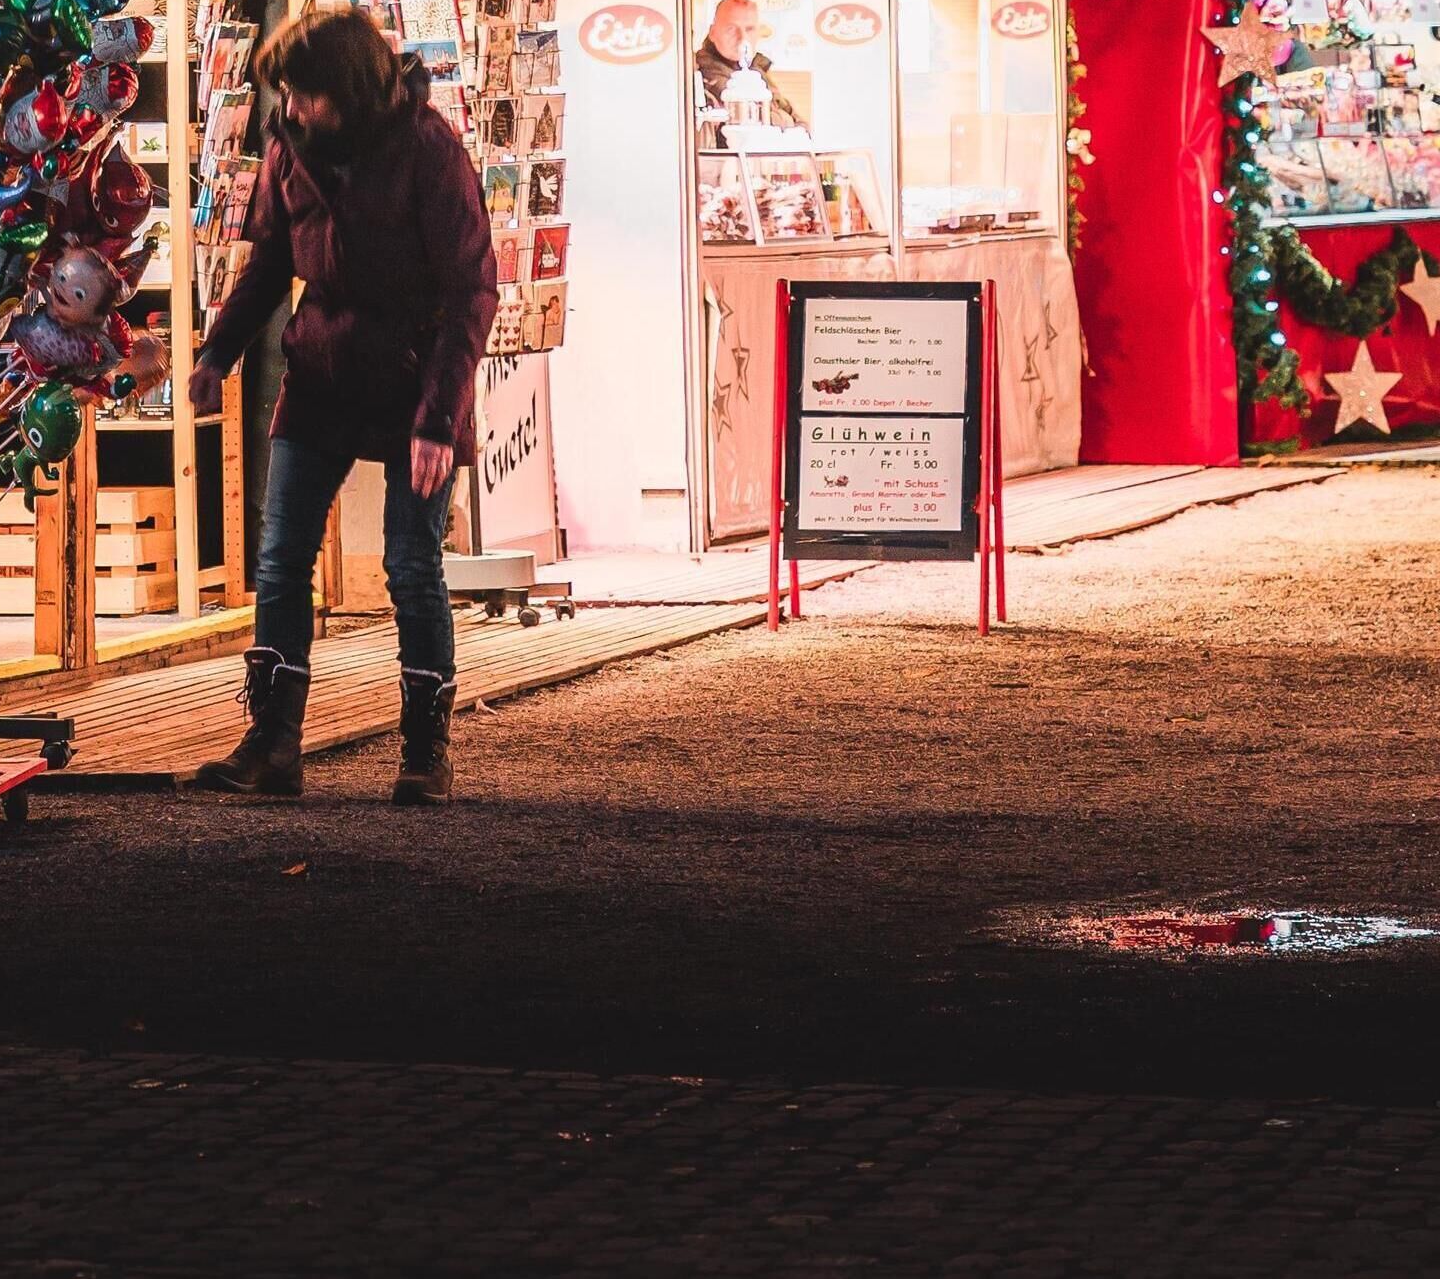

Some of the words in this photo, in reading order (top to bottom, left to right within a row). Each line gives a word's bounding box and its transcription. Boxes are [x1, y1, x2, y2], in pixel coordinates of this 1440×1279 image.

[814, 326, 881, 335] Feldschlösschen
[884, 327, 901, 335] Bier
[813, 356, 860, 365] Clausthaler
[888, 356, 934, 366] alkoholfrei
[811, 426, 931, 441] Glühwein
[485, 388, 537, 495] Guete!
[810, 460, 823, 469] 20
[827, 460, 836, 469] cl
[913, 460, 938, 469] 5.00
[884, 479, 899, 488] mit
[904, 479, 939, 488] Schuss
[853, 503, 872, 514] plus
[913, 503, 937, 512] 3.00
